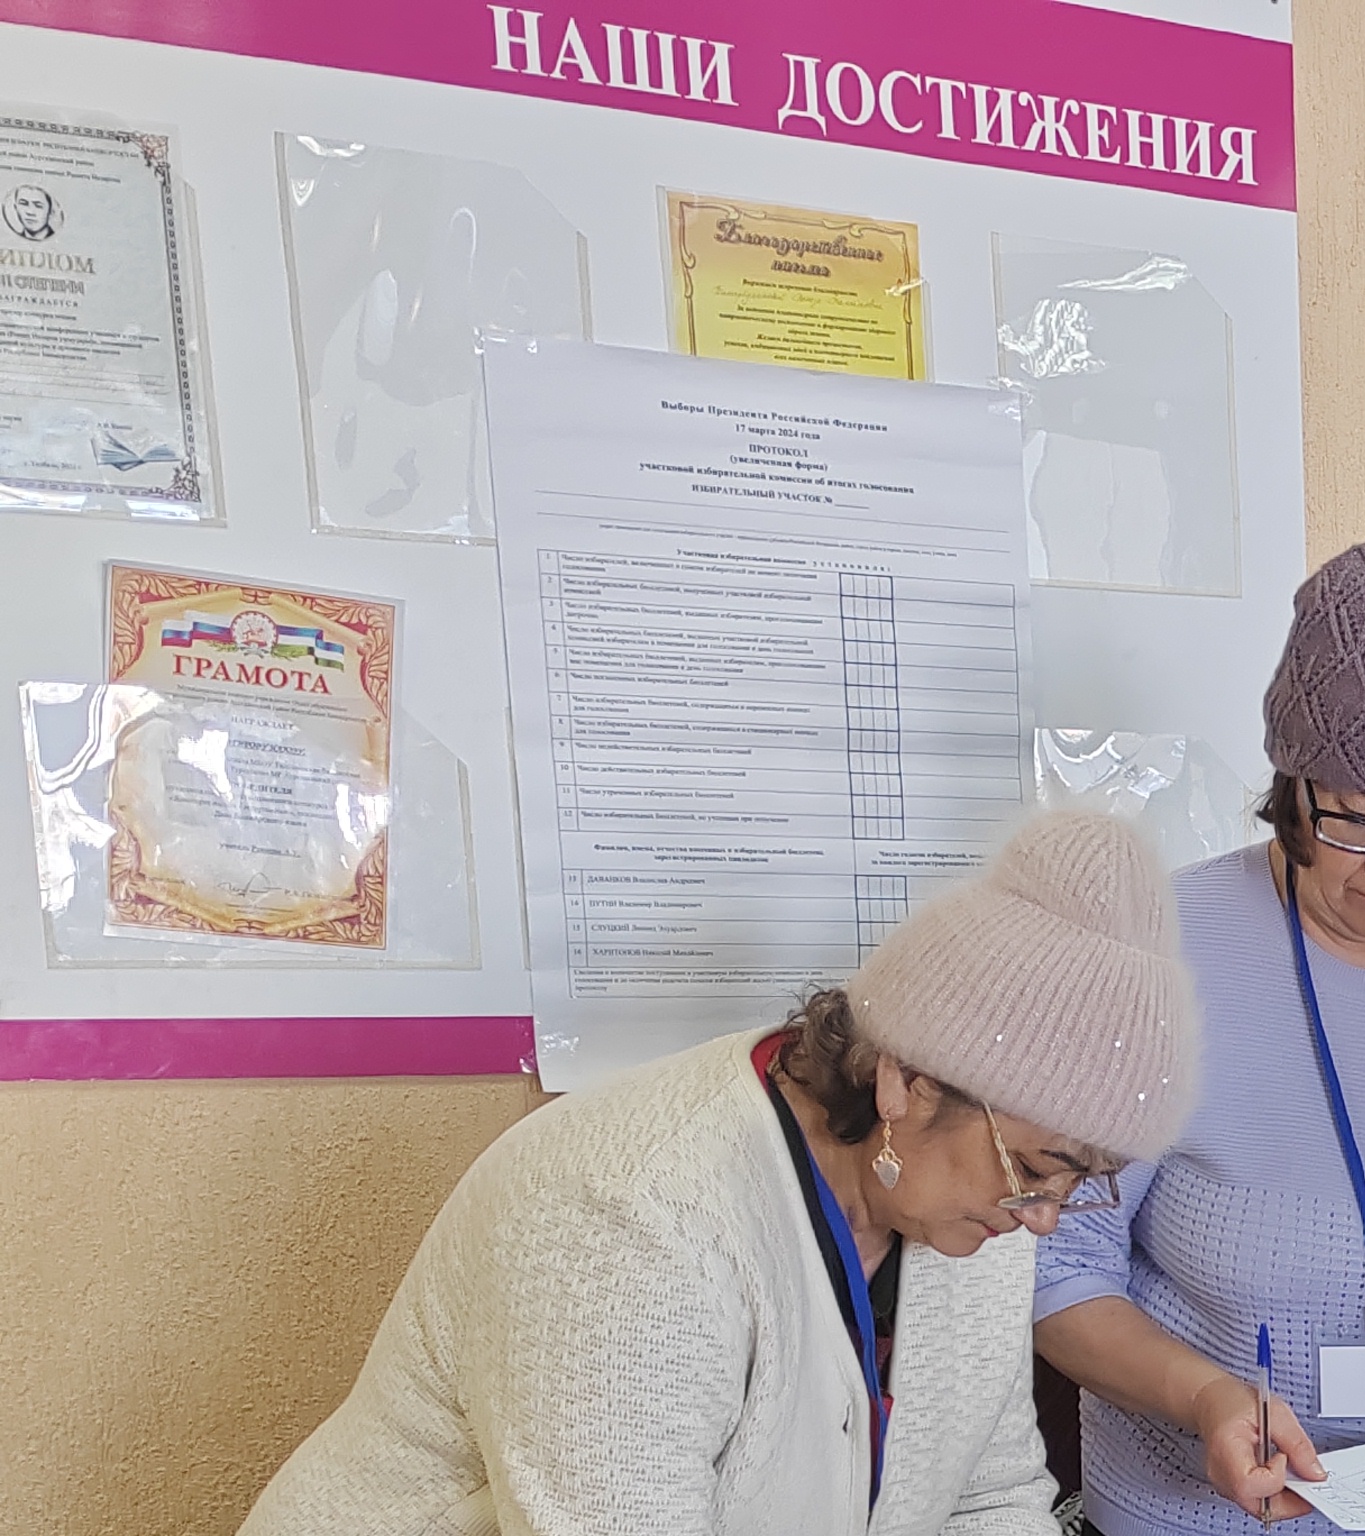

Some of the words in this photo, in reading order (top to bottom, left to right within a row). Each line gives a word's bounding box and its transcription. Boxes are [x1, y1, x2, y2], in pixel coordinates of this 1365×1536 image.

[486, 4, 740, 107] НАШИ
[777, 52, 1260, 188] ДОСТИЖЕНИЯ
[0, 248, 97, 275] ИПЛОМ
[661, 400, 704, 413] Выборы
[708, 405, 768, 420] Президента
[771, 412, 830, 427] Российской
[832, 418, 888, 432] Федерации
[735, 424, 746, 433] 17
[748, 426, 776, 437] марта
[778, 427, 799, 438] 2024
[748, 444, 808, 458] ПРОТОКОЛ
[691, 484, 775, 499] ИЗБИРАТЕЛЬНЫЙ
[778, 491, 822, 503] УЧАСТОК
[172, 653, 333, 696] ГРАМОТА
